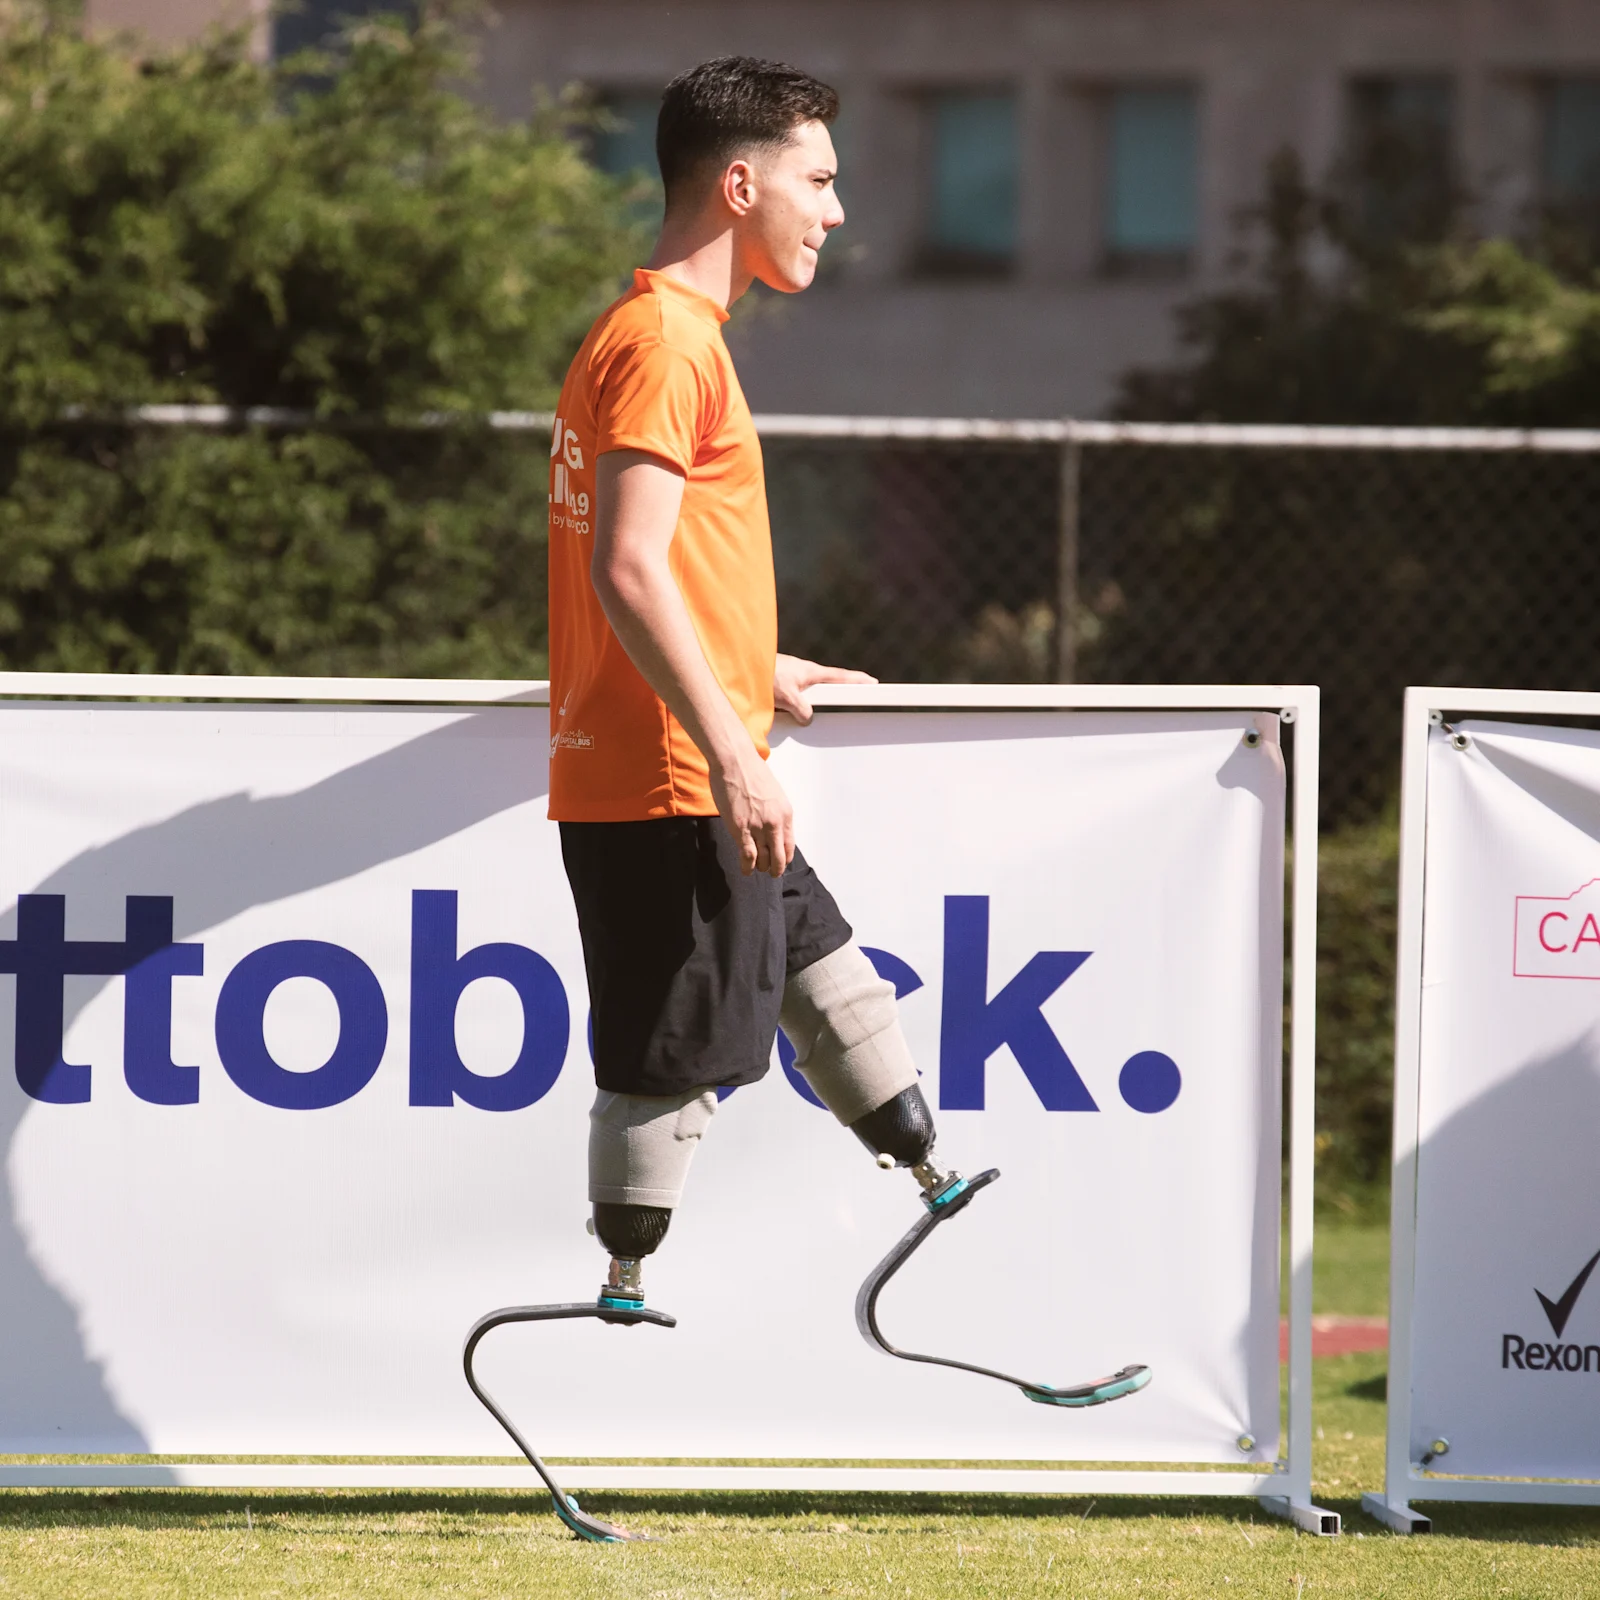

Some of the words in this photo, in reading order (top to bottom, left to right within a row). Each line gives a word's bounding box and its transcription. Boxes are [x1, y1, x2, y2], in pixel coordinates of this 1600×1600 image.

[1539, 911, 1600, 953] CA
[0, 889, 1182, 1114] ttobk.
[1502, 1334, 1600, 1372] Rexon
